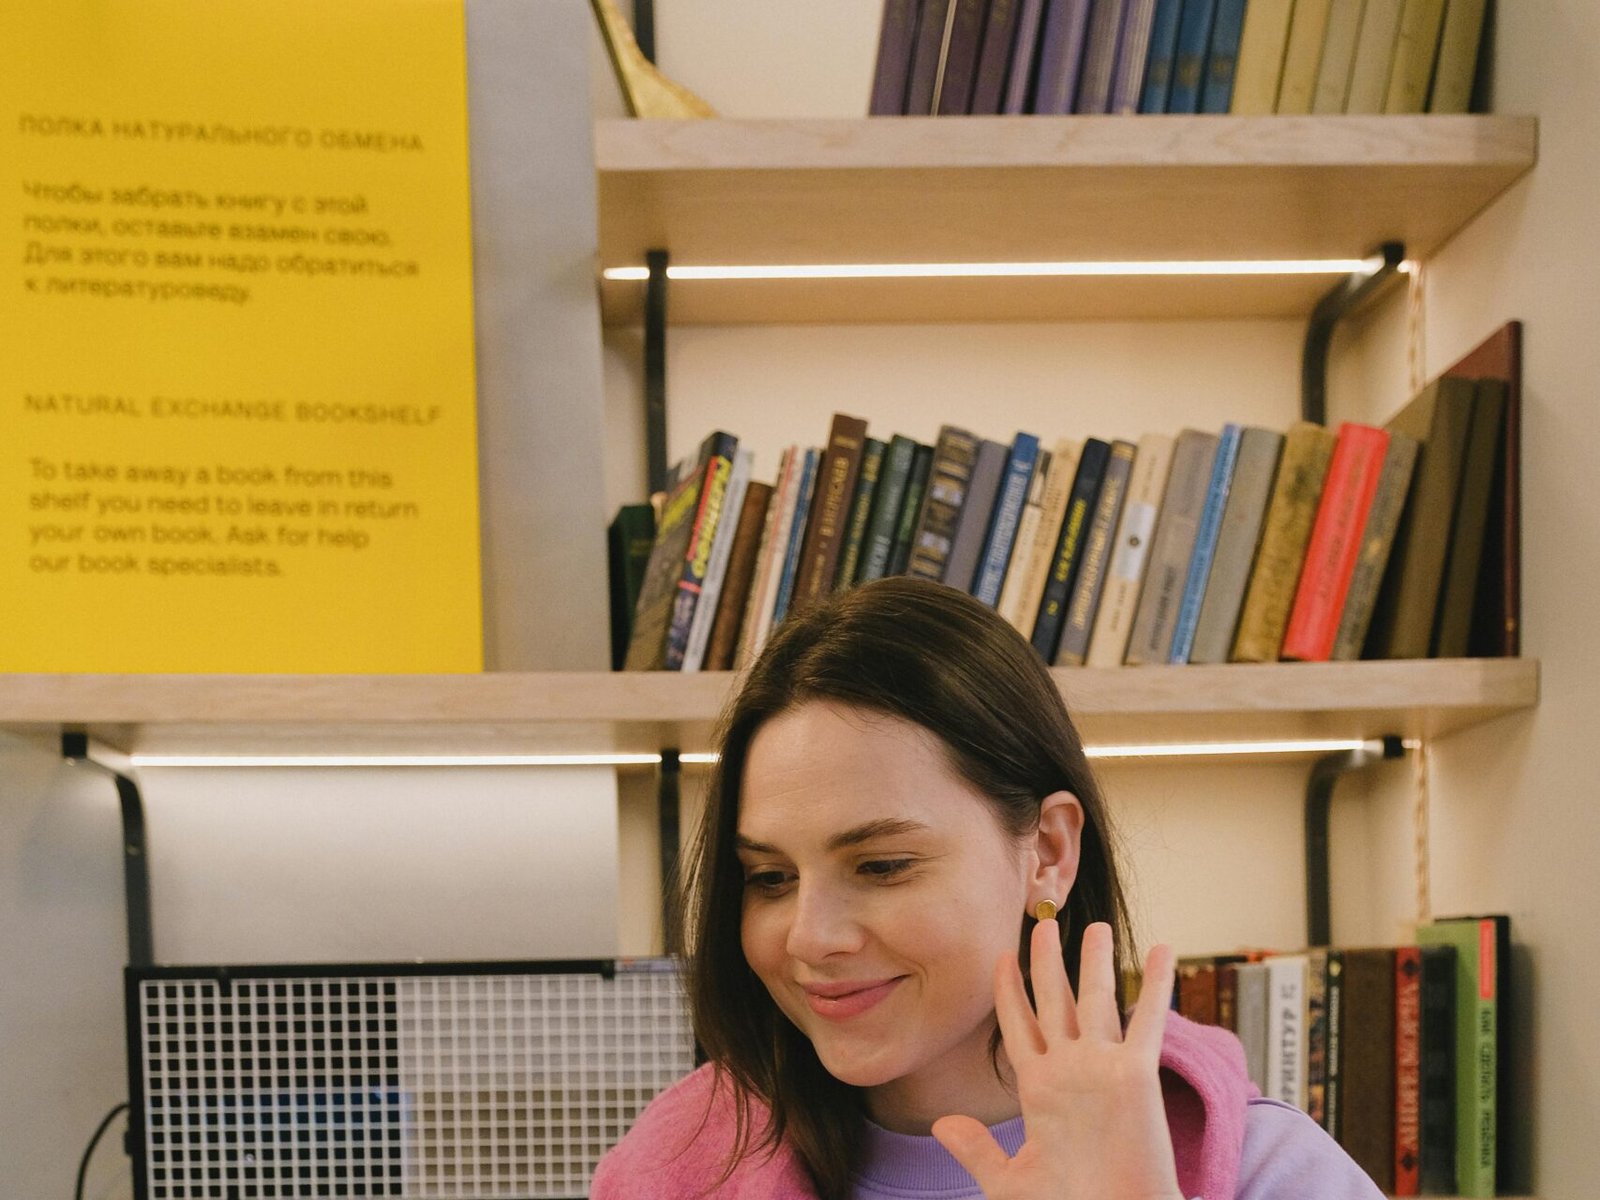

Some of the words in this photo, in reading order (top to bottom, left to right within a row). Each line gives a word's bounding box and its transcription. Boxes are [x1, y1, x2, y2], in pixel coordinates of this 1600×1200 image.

[19, 114, 105, 137] ПОЛКА
[112, 119, 313, 149] НАТУРАЛЬНОГО
[319, 129, 424, 153] ОБМЕНА
[23, 182, 104, 205] Чтобы
[110, 185, 210, 210] забрать
[214, 194, 287, 217] книгу
[314, 195, 369, 216] этой
[112, 219, 223, 240] оставьте
[23, 240, 73, 266] Для
[79, 247, 150, 268] этого
[154, 251, 203, 269] вам
[207, 253, 272, 274] надо
[275, 253, 420, 278] обратиться
[24, 393, 141, 418] NATURAL
[150, 396, 286, 422] EXCHANGE
[294, 401, 441, 426] BOOKSHELF
[28, 456, 58, 481] To
[63, 462, 119, 482] take
[125, 465, 190, 488] away
[195, 467, 211, 484] a
[216, 465, 278, 486] book
[283, 464, 343, 488] from
[347, 469, 394, 490] this
[29, 490, 92, 512] shelf
[96, 495, 143, 517] you
[147, 495, 210, 515] need
[214, 496, 243, 516] to
[247, 496, 313, 517] leave
[317, 499, 340, 517] in
[344, 500, 419, 520] return
[28, 524, 85, 547] your
[93, 525, 146, 542] own
[226, 525, 270, 546] Ask
[276, 525, 311, 547] for
[317, 528, 370, 551] help
[29, 554, 71, 573] our
[77, 553, 140, 574] book
